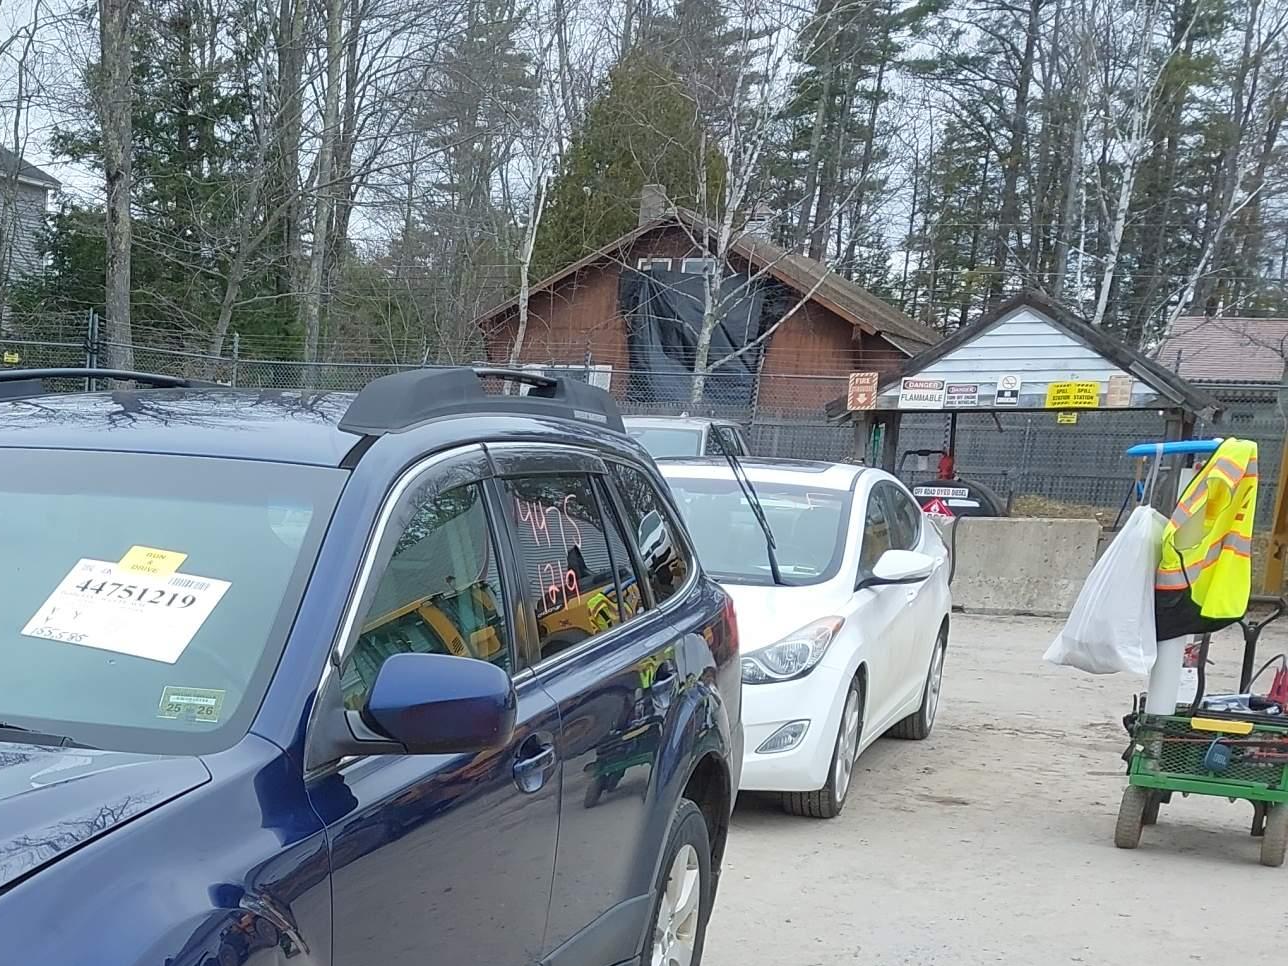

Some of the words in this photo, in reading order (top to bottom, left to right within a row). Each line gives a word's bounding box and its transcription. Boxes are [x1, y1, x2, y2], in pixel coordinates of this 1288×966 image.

[900, 393, 943, 401] FLAMMABLE
[76, 578, 197, 609] 44751219
[166, 703, 181, 713] 25
[197, 705, 214, 715] 26
